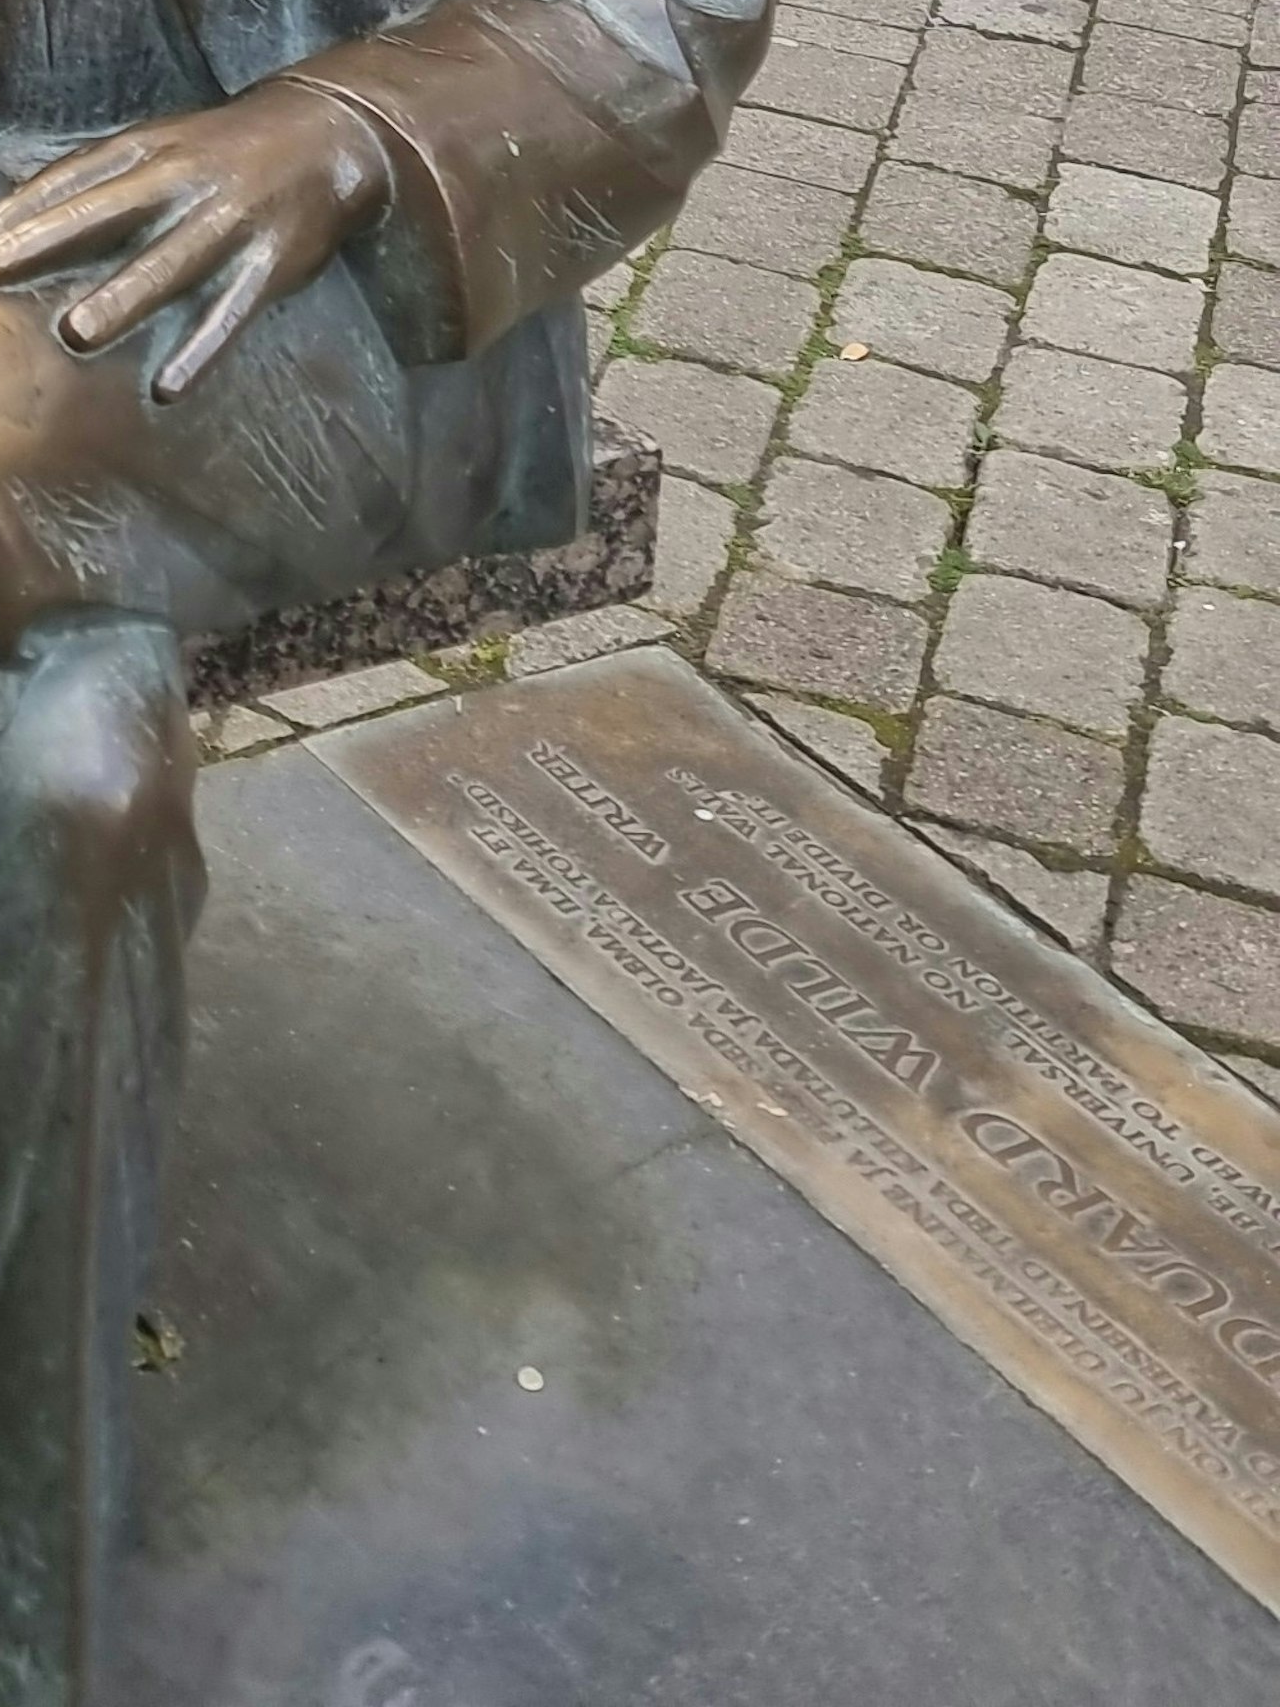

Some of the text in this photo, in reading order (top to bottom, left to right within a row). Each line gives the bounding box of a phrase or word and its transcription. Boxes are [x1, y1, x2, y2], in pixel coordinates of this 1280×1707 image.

[526, 741, 673, 864] WRITER
[758, 845, 924, 963] NATIONAL
[781, 831, 893, 905] DIVIDE
[678, 879, 938, 1094] WILDE
[890, 915, 949, 950] OR
[920, 970, 983, 1010] NO
[943, 958, 1130, 1093] PARTITION
[1000, 1037, 1196, 1184] UNIVERSAL
[1127, 1099, 1184, 1140] TO
